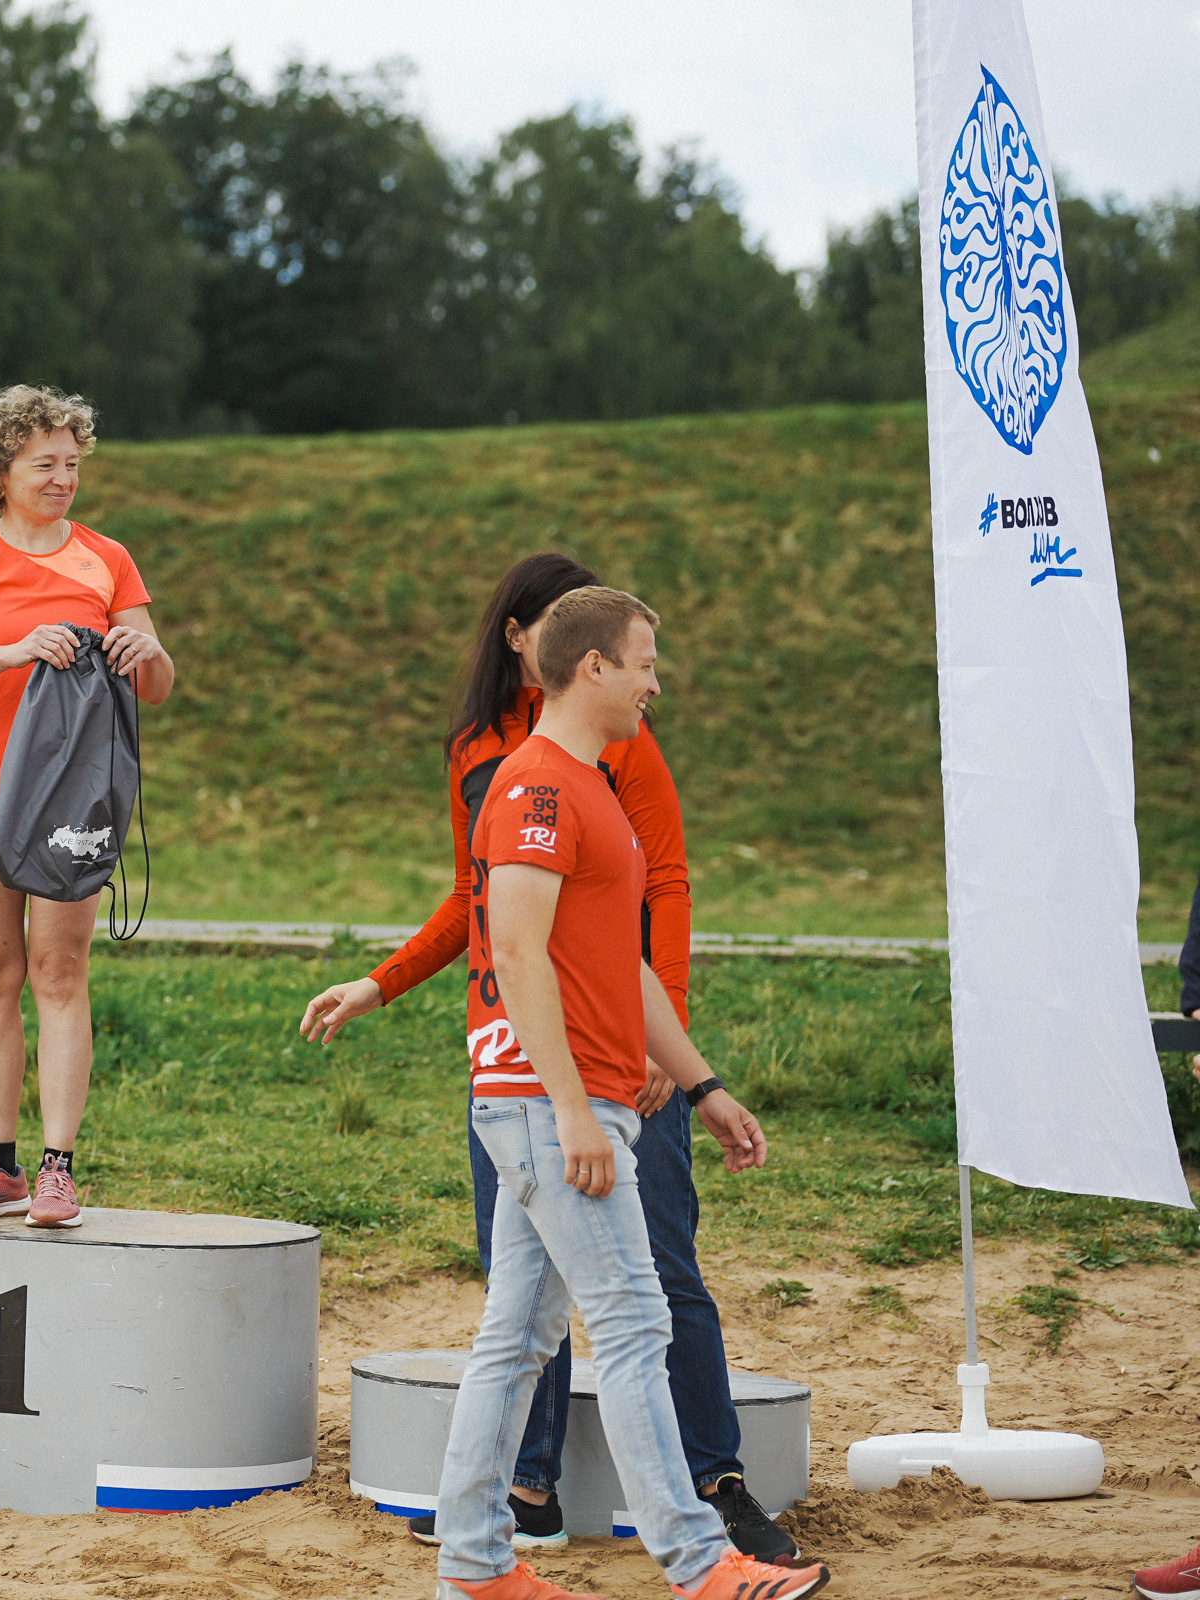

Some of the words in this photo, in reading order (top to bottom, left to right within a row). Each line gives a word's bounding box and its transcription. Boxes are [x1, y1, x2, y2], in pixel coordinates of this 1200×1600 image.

[507, 784, 560, 800] #nov
[533, 797, 558, 812] go
[523, 810, 557, 827] rod
[60, 837, 95, 847] VERSTA
